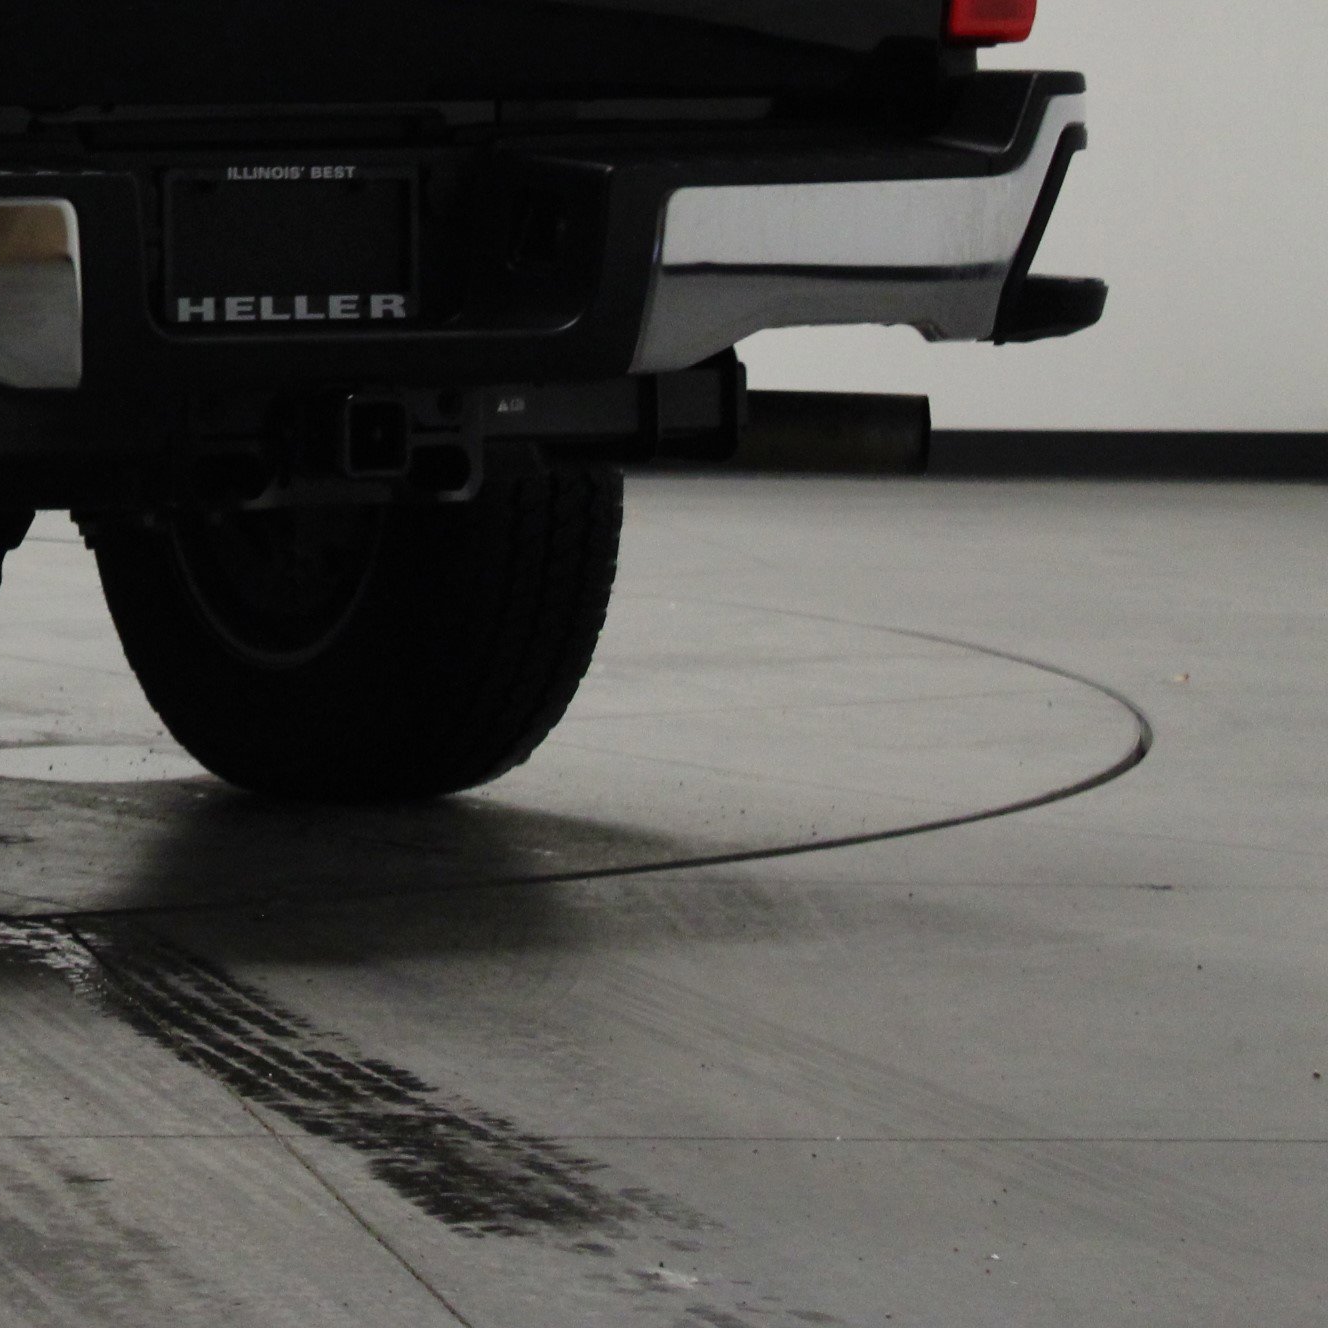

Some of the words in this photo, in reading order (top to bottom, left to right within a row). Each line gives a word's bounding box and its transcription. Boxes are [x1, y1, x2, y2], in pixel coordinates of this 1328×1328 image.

[226, 165, 306, 181] ILLINOIS'
[310, 165, 357, 180] BEST
[176, 292, 407, 323] HELLER
